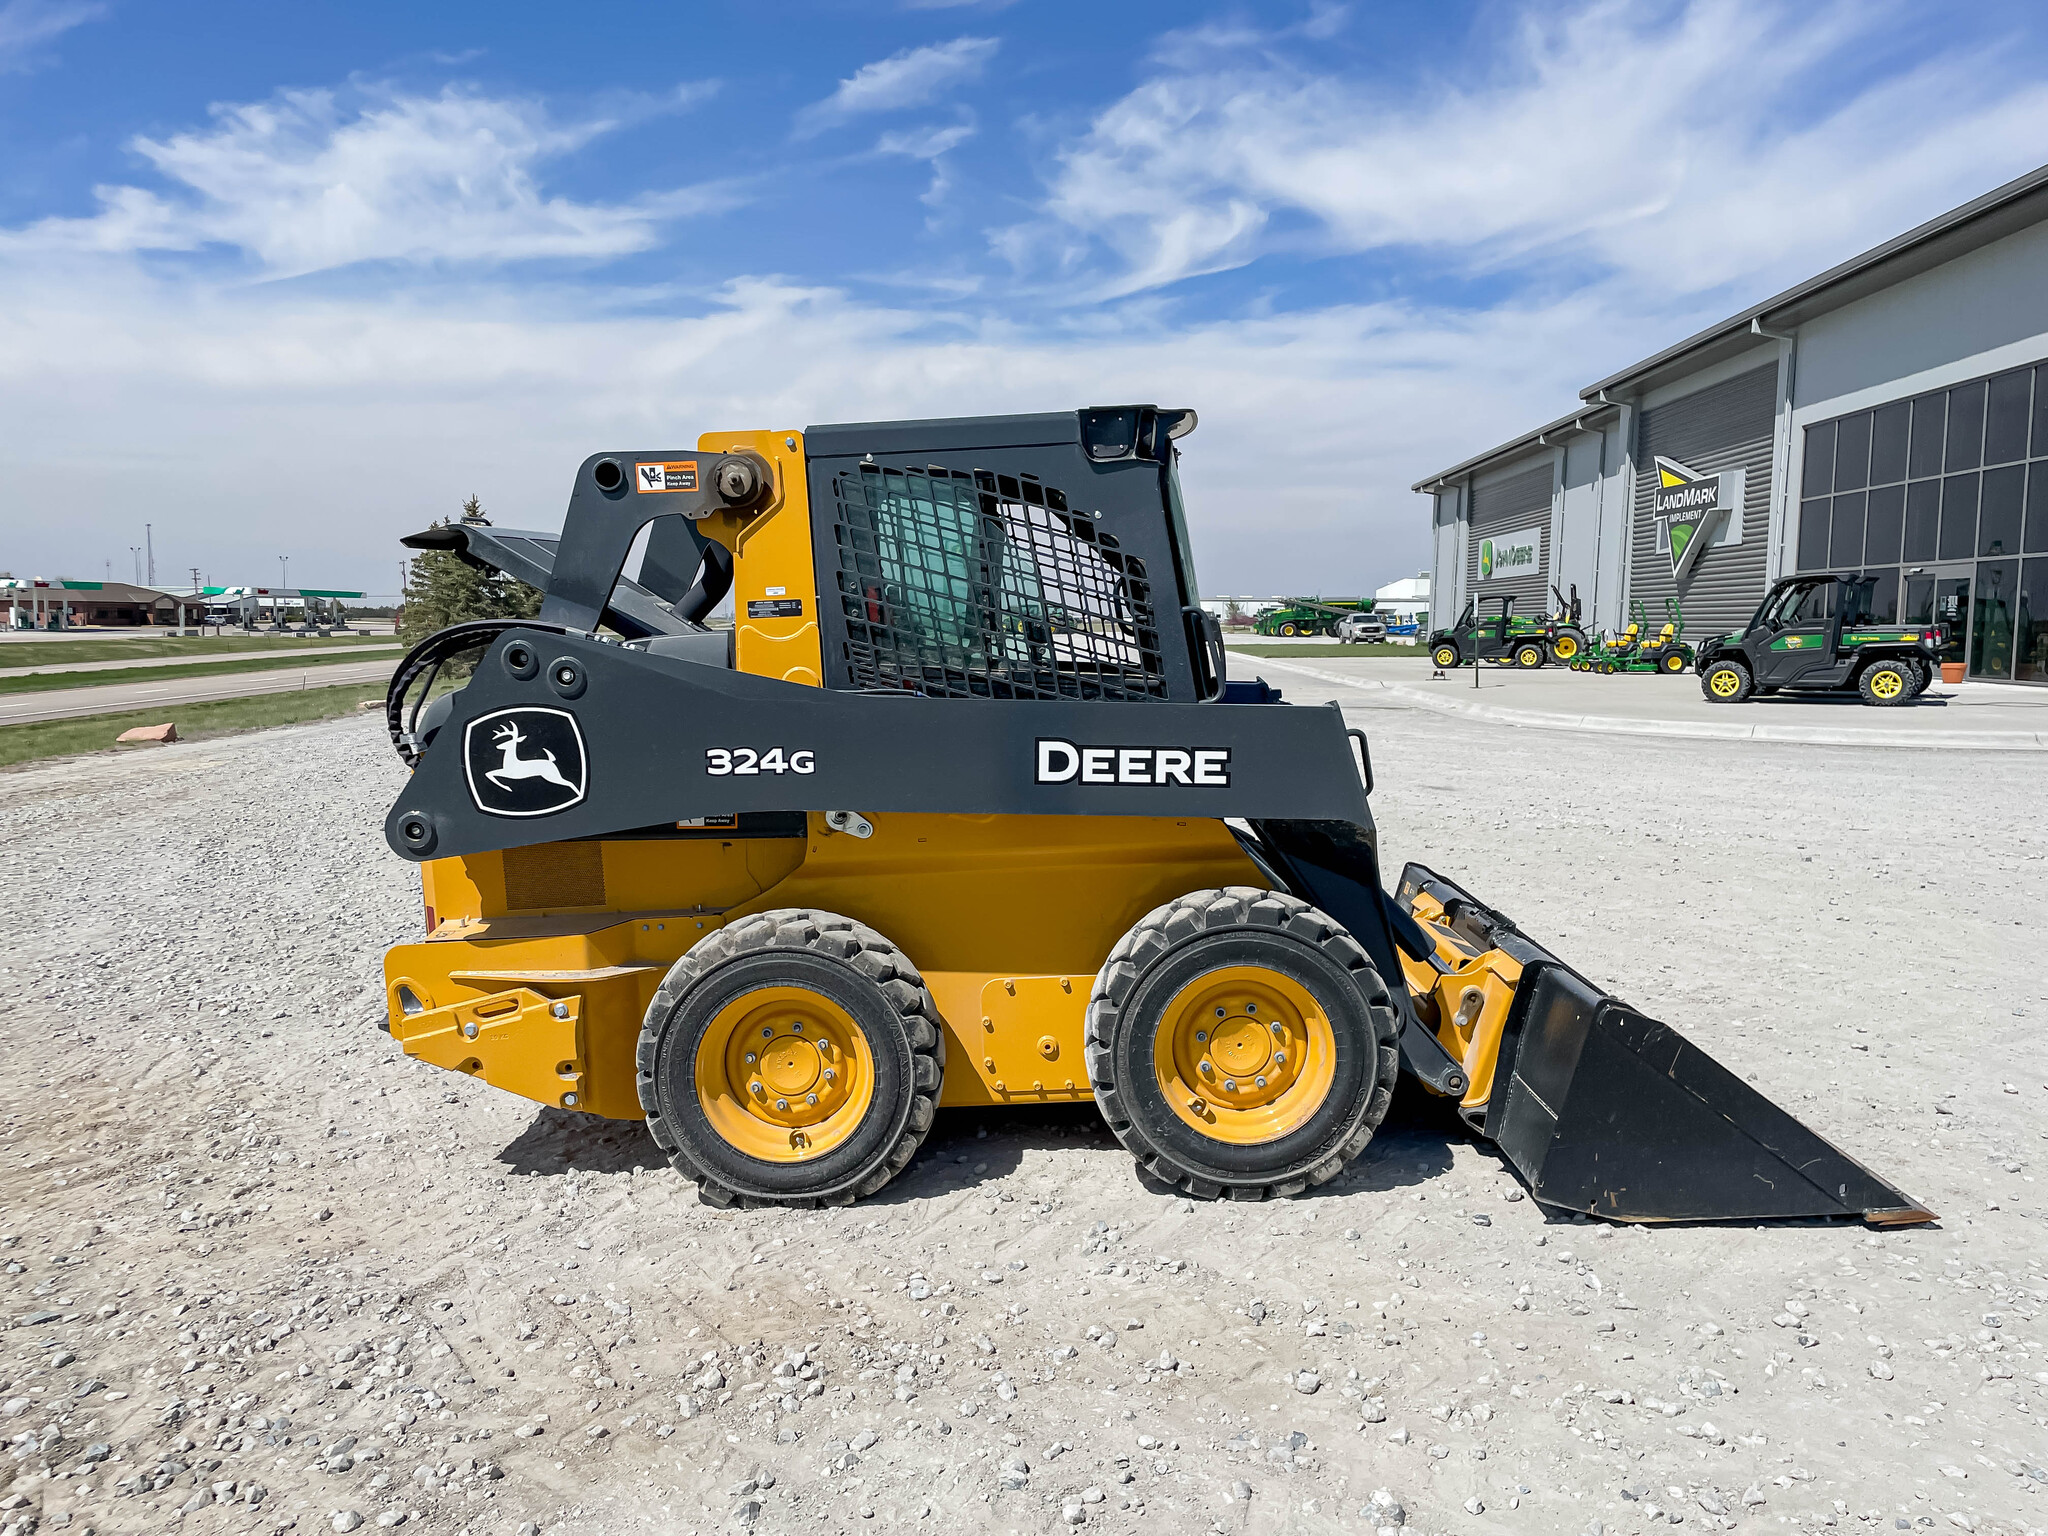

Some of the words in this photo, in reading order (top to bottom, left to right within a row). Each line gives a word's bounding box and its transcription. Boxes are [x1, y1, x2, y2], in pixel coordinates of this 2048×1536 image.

[1669, 509, 1702, 523] IMPLEMENT
[706, 747, 815, 776] 324G
[1037, 739, 1229, 786] DEERE
